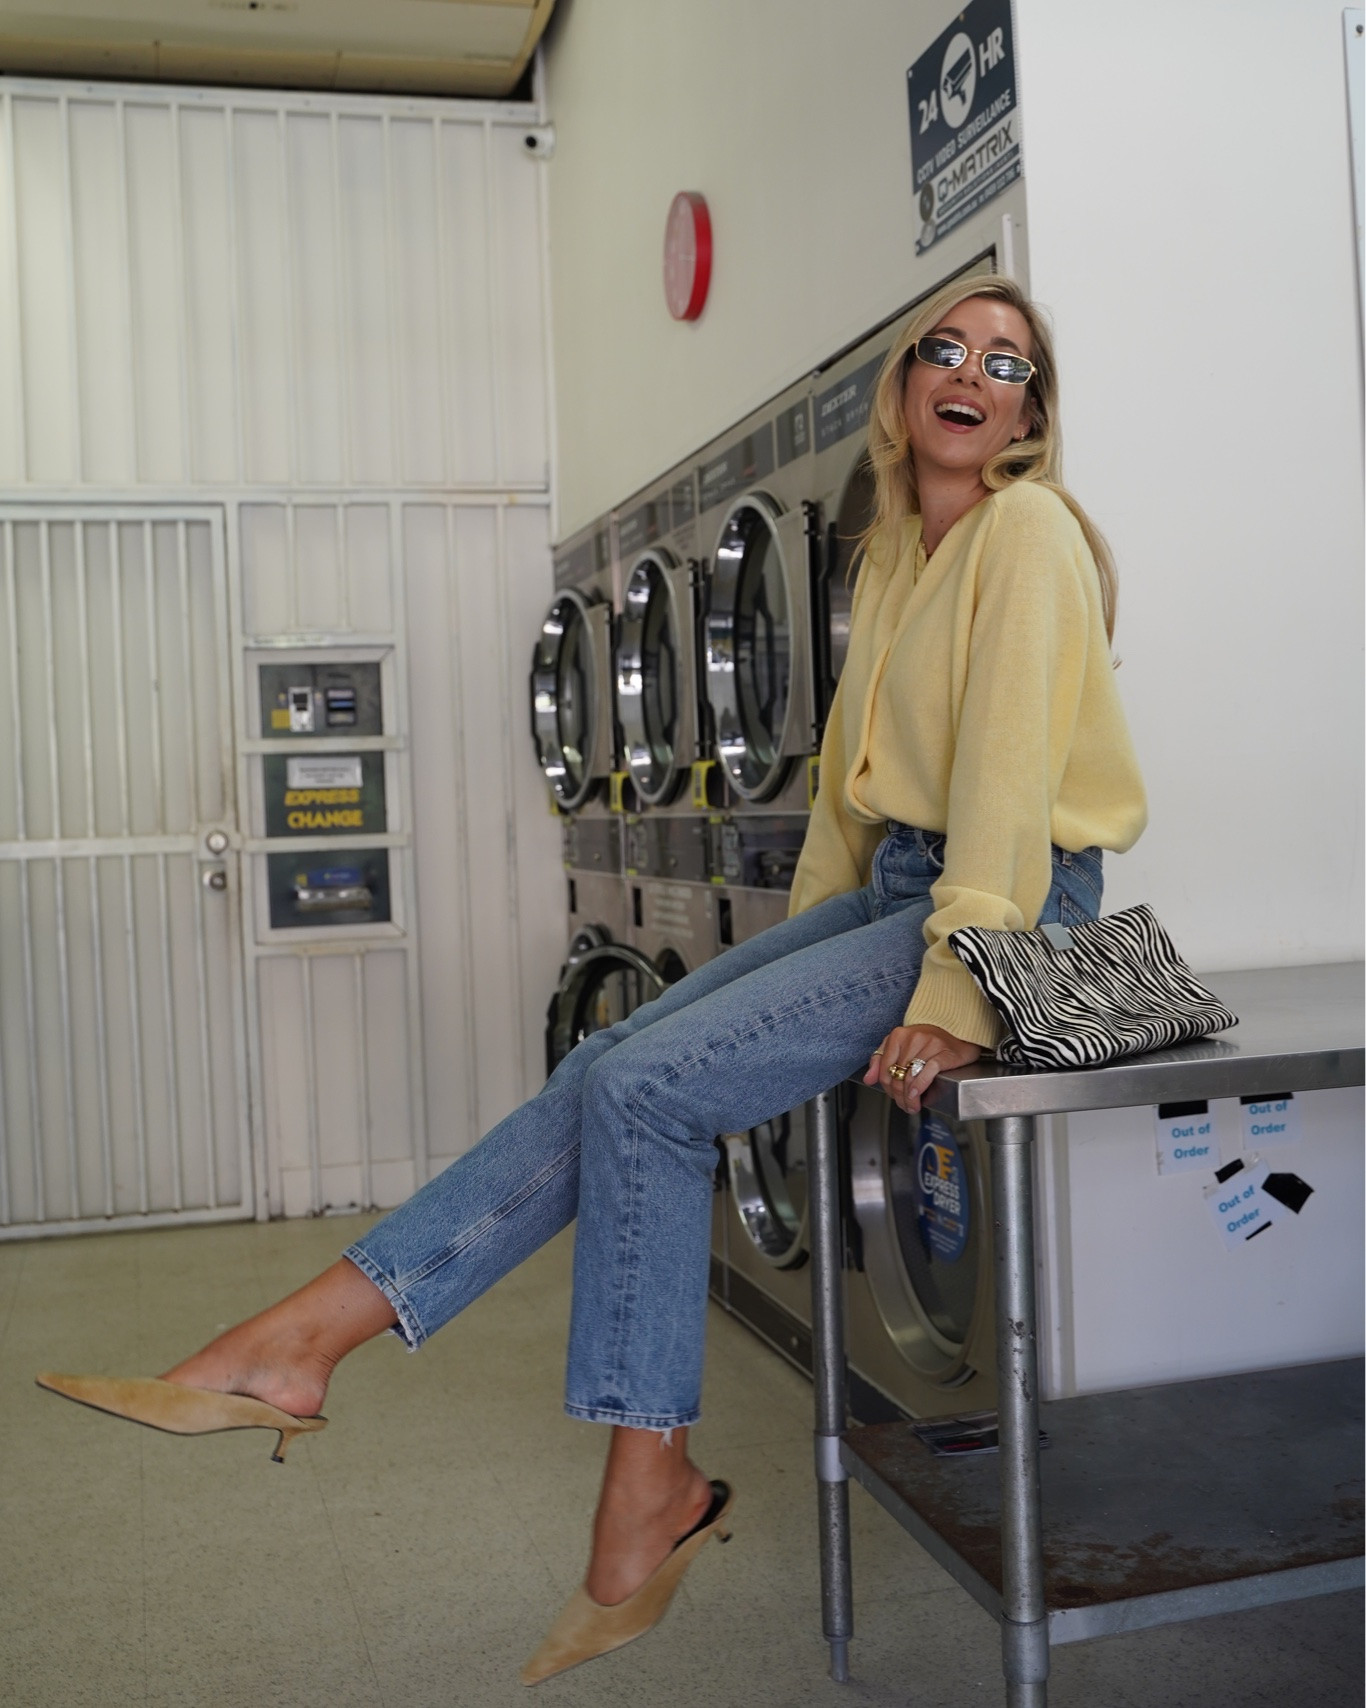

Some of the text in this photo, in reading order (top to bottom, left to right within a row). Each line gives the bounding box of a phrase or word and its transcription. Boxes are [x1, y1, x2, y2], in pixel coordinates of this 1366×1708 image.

[918, 26, 1005, 135] 24 HR
[917, 156, 935, 184] CCTV
[935, 138, 957, 169] VIDEO
[957, 88, 1011, 148] SURVEILLANCE
[284, 788, 360, 806] EXPRESS
[287, 809, 363, 829] CHANGE
[1249, 1100, 1288, 1115] Out of
[1171, 1122, 1211, 1138] Out of
[1251, 1122, 1286, 1135] Order
[1173, 1145, 1209, 1159] Order
[924, 1172, 960, 1199] EXPRESS
[933, 1191, 961, 1216] DRYER
[1218, 1185, 1255, 1213] Out of
[1227, 1208, 1260, 1233] Order
